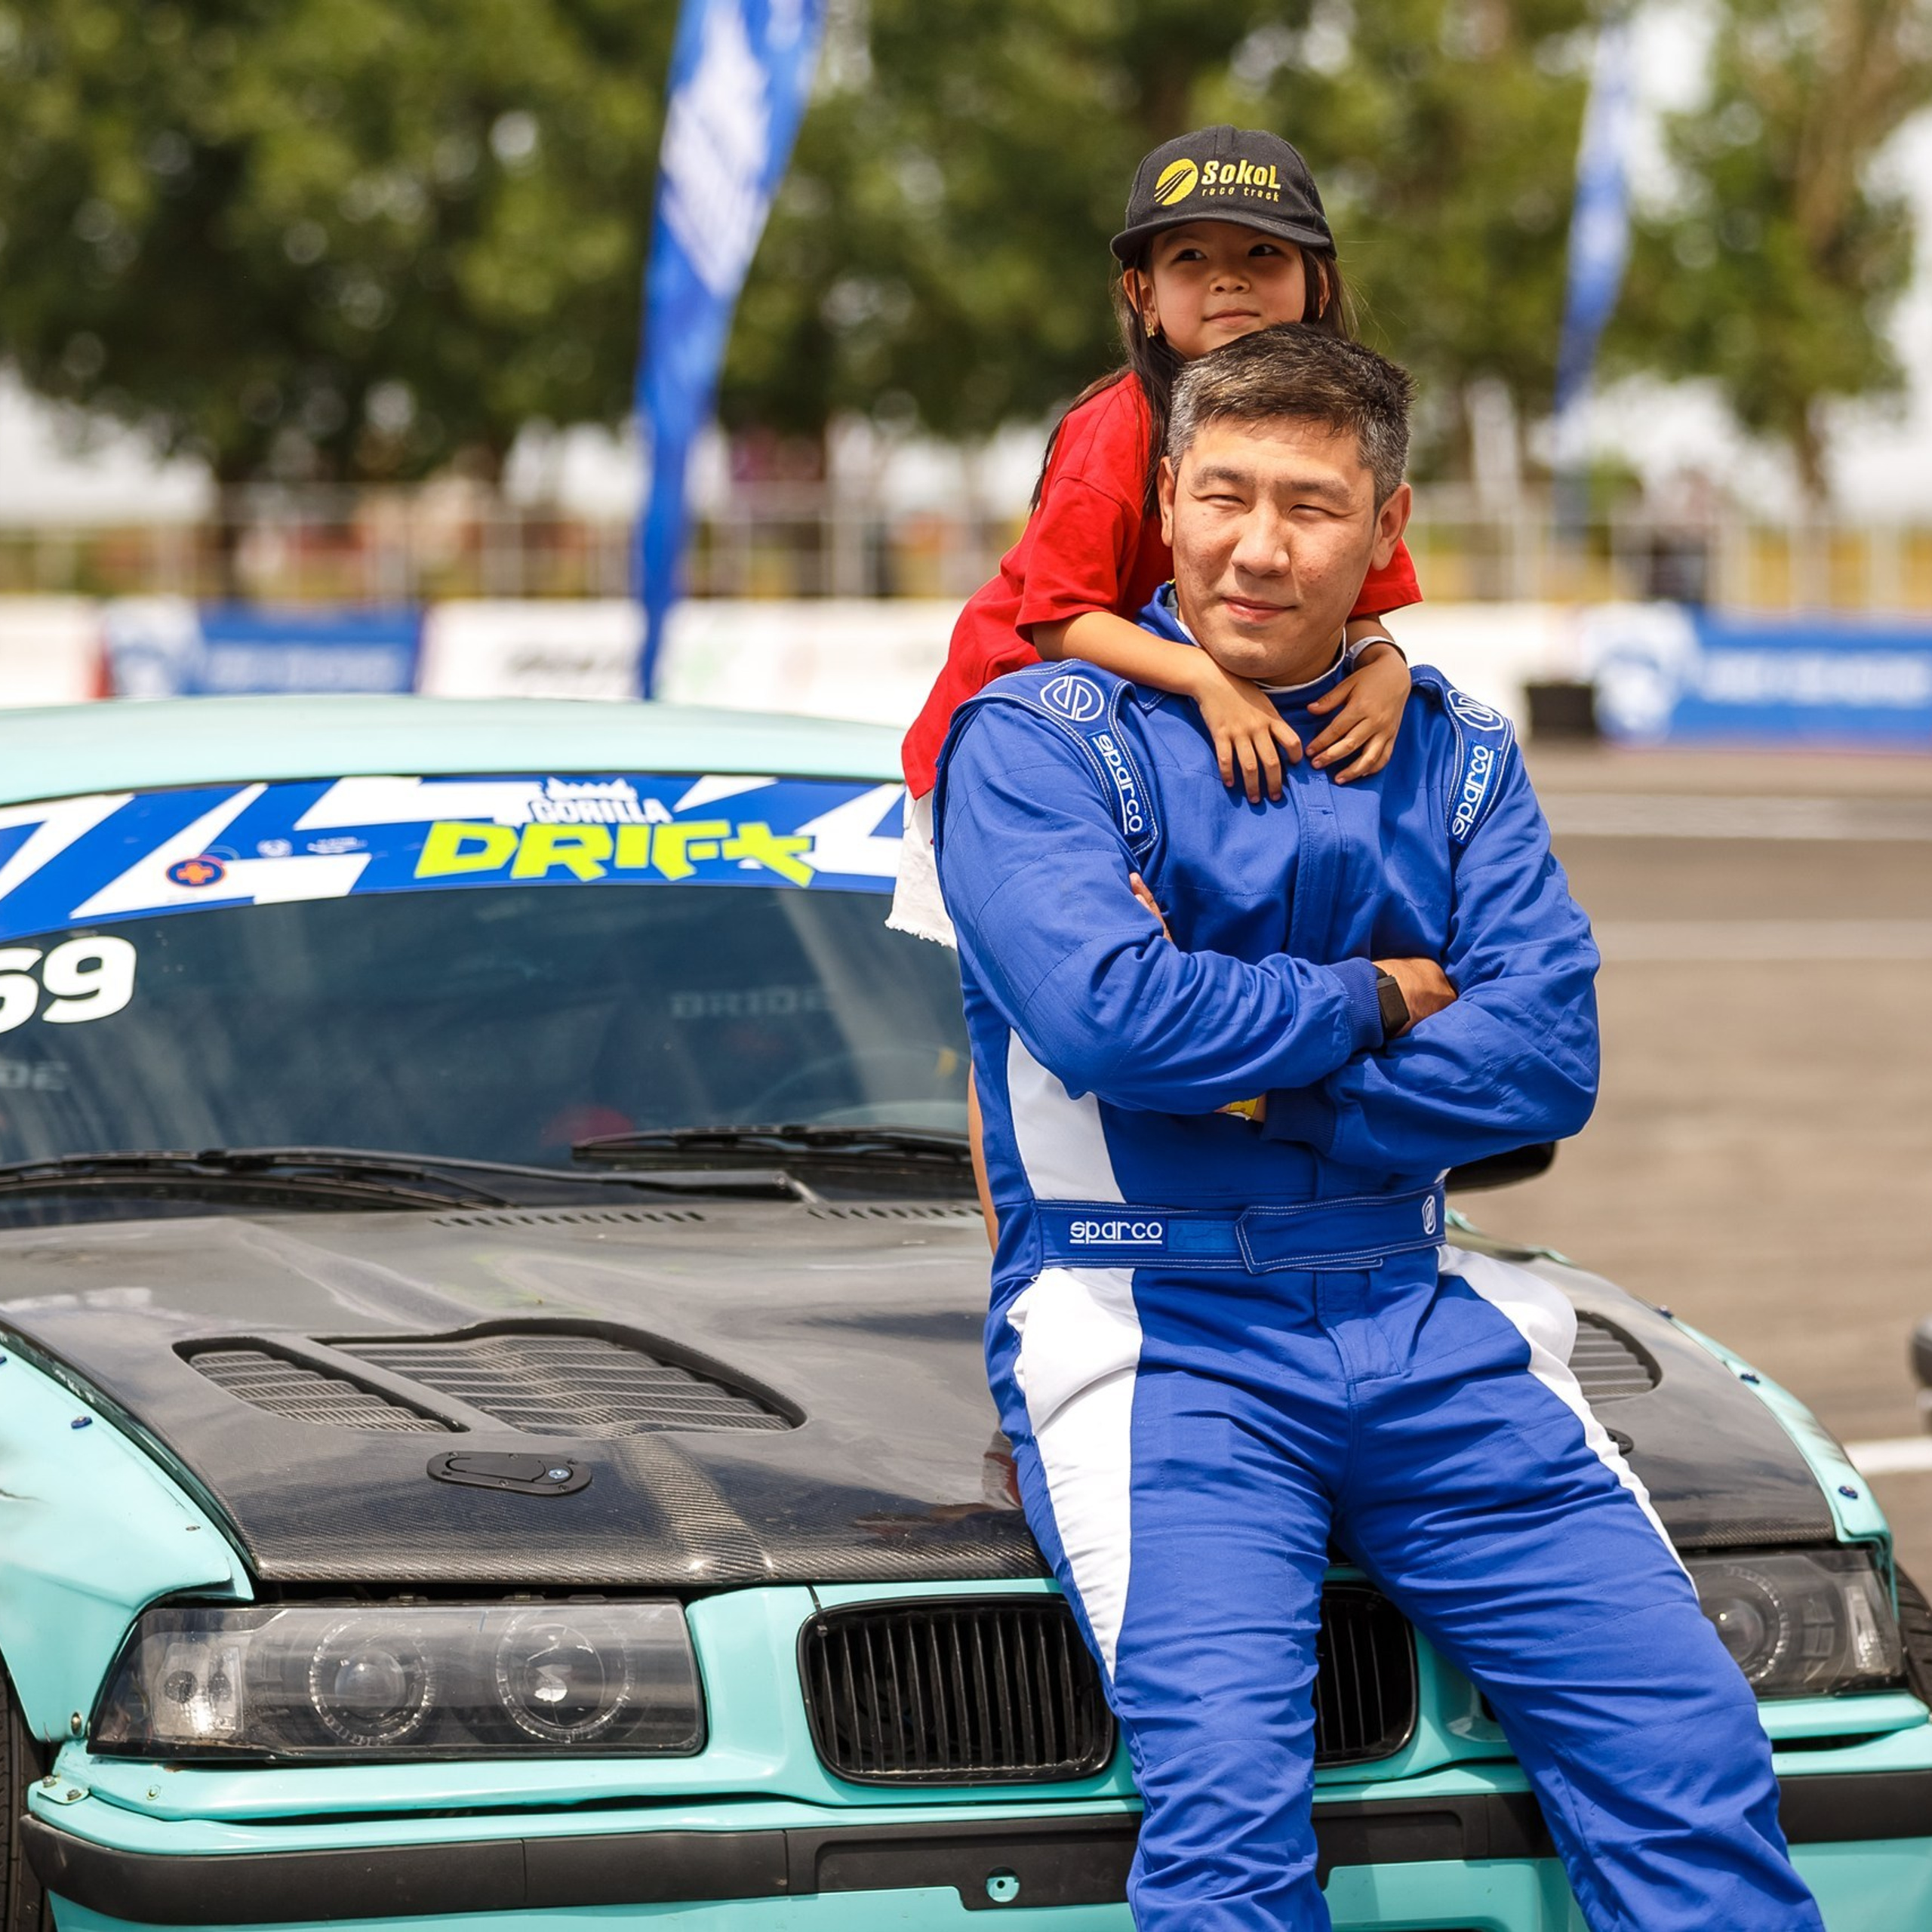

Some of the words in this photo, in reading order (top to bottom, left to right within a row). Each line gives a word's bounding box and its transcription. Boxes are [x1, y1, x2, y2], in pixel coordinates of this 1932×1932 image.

[1201, 186, 1235, 196] race
[1244, 186, 1279, 202] track
[1092, 734, 1143, 835] sparco
[1452, 746, 1494, 841] sparco
[529, 798, 674, 824] GORILLA
[414, 820, 814, 888] DRIFT
[1069, 1220, 1163, 1244] sparco
